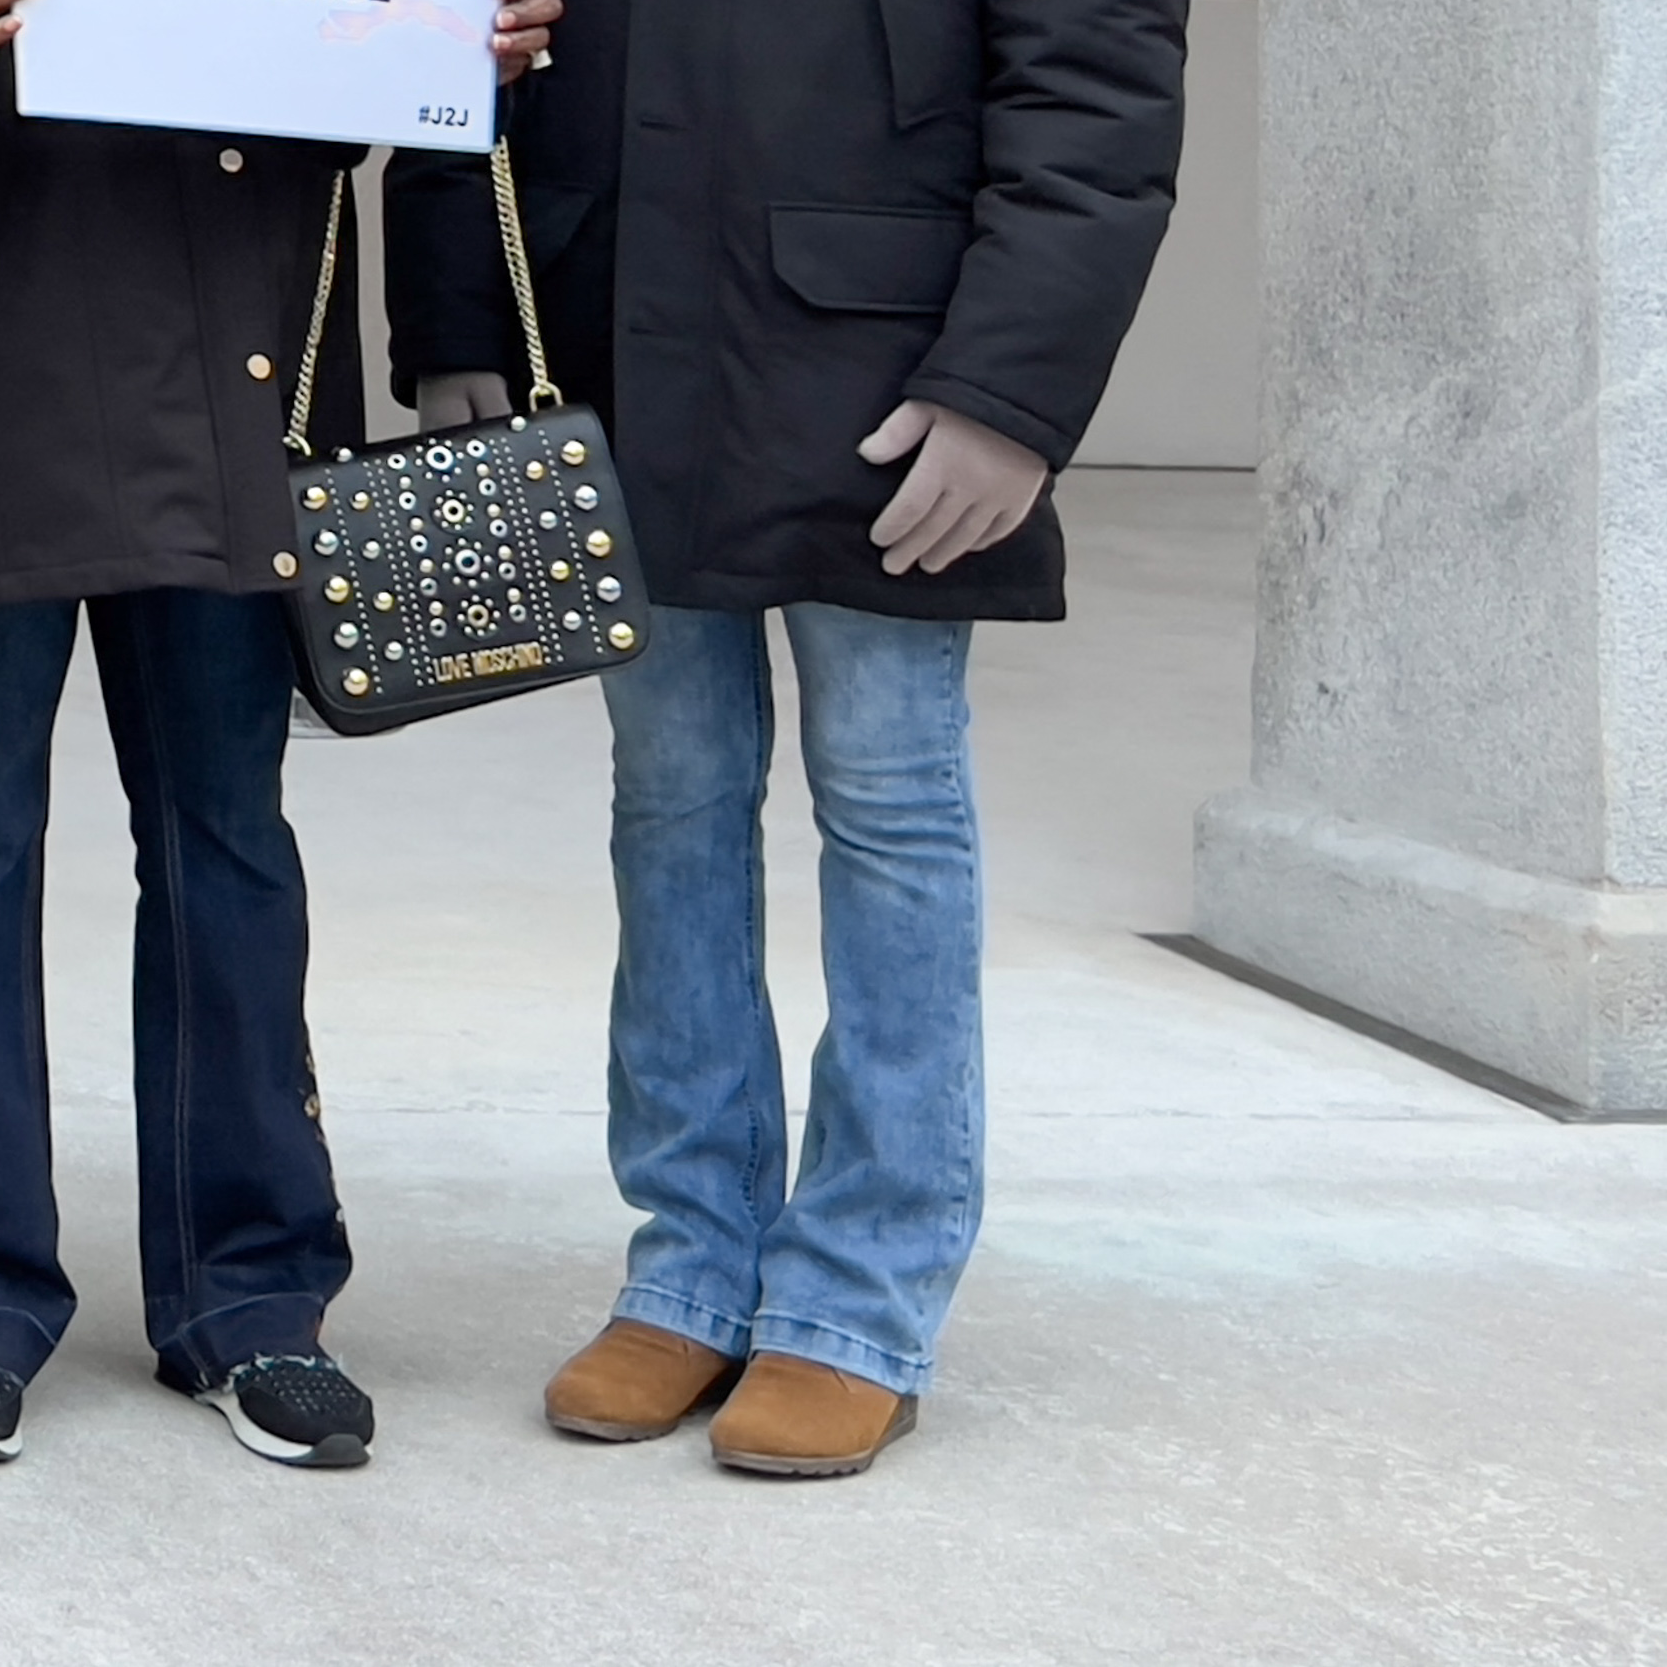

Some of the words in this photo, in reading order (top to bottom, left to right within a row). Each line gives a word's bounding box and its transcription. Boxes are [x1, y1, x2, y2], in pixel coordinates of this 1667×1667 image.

[418, 105, 469, 128] #J2J
[433, 653, 471, 682] LOVE
[471, 642, 542, 675] MOSCHINO
